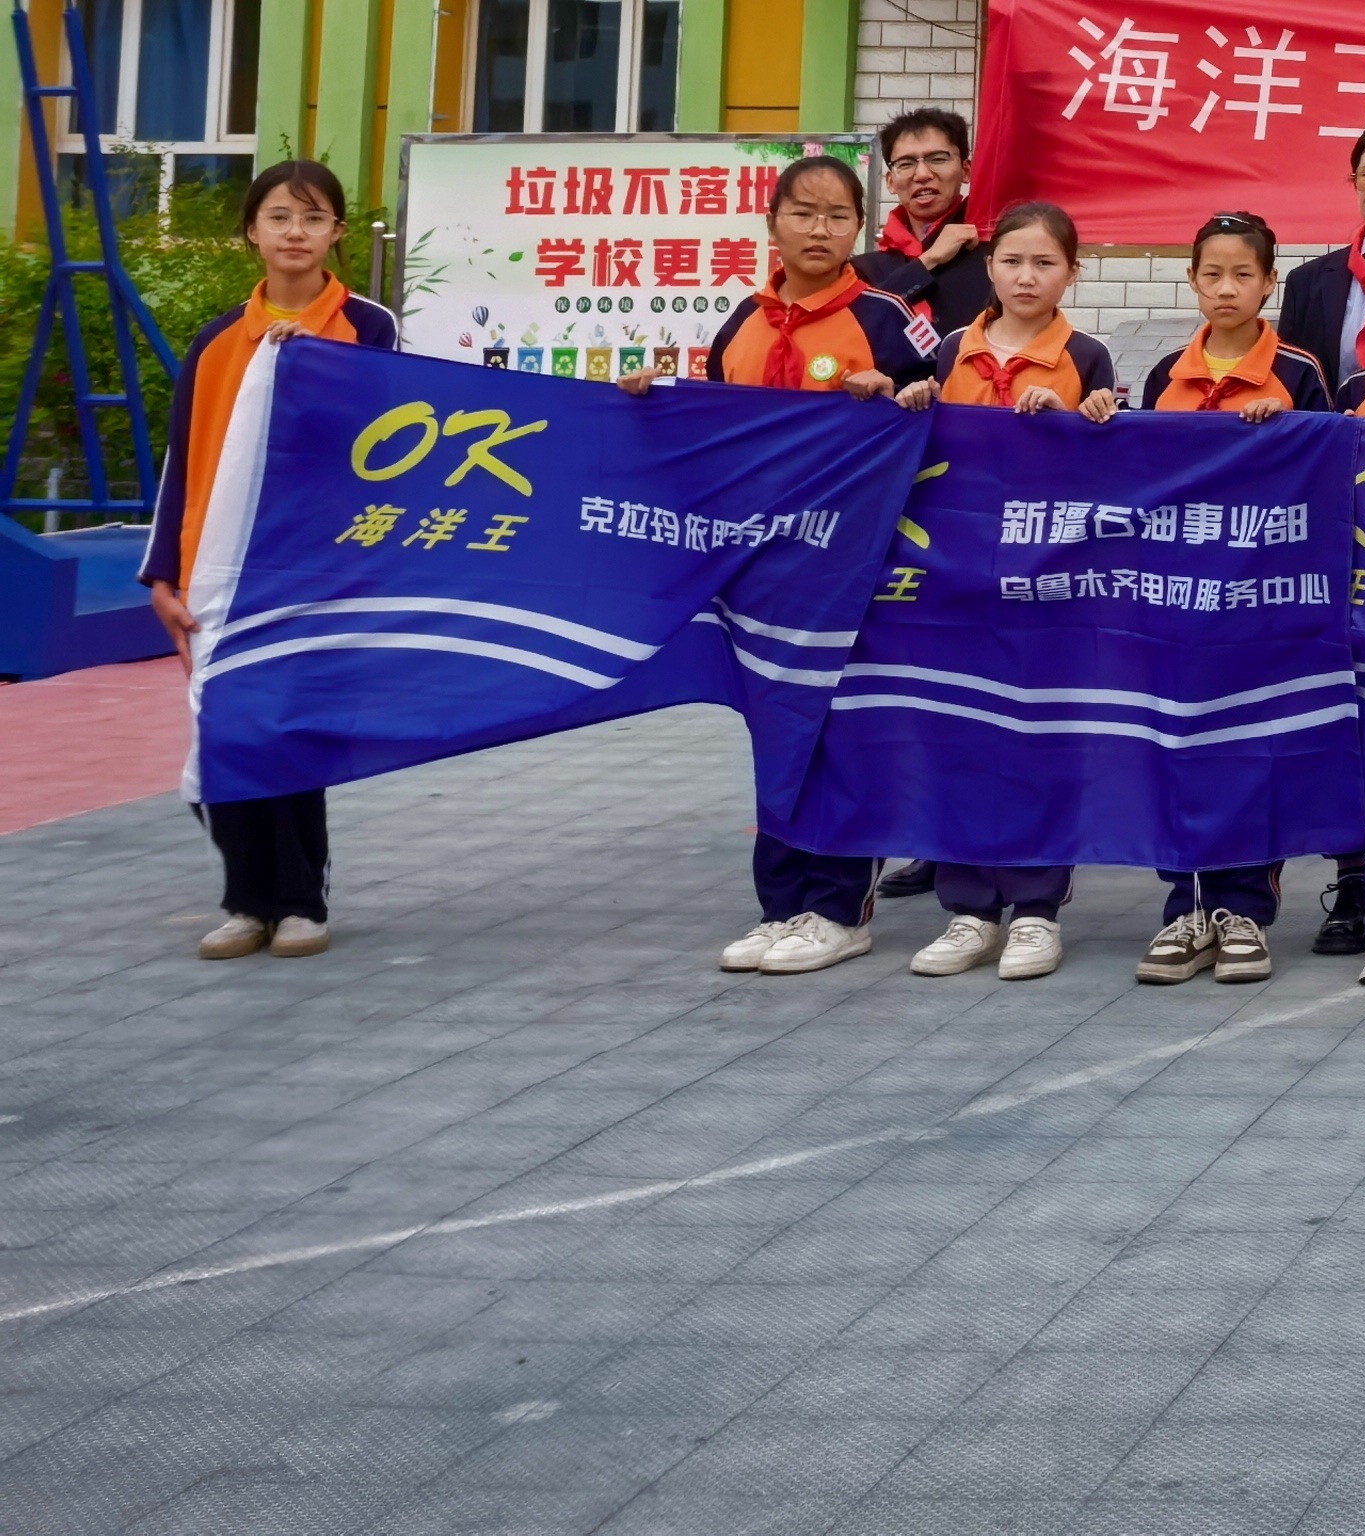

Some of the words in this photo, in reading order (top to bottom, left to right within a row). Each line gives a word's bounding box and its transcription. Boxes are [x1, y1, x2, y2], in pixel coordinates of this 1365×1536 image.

[504, 165, 780, 216] 垃圾不落地
[350, 400, 549, 498] OK
[334, 504, 529, 553] 海洋王
[1000, 500, 1308, 548] 新疆石油事业部
[1000, 568, 1331, 612] 乌鲁木齐电网服务中心
